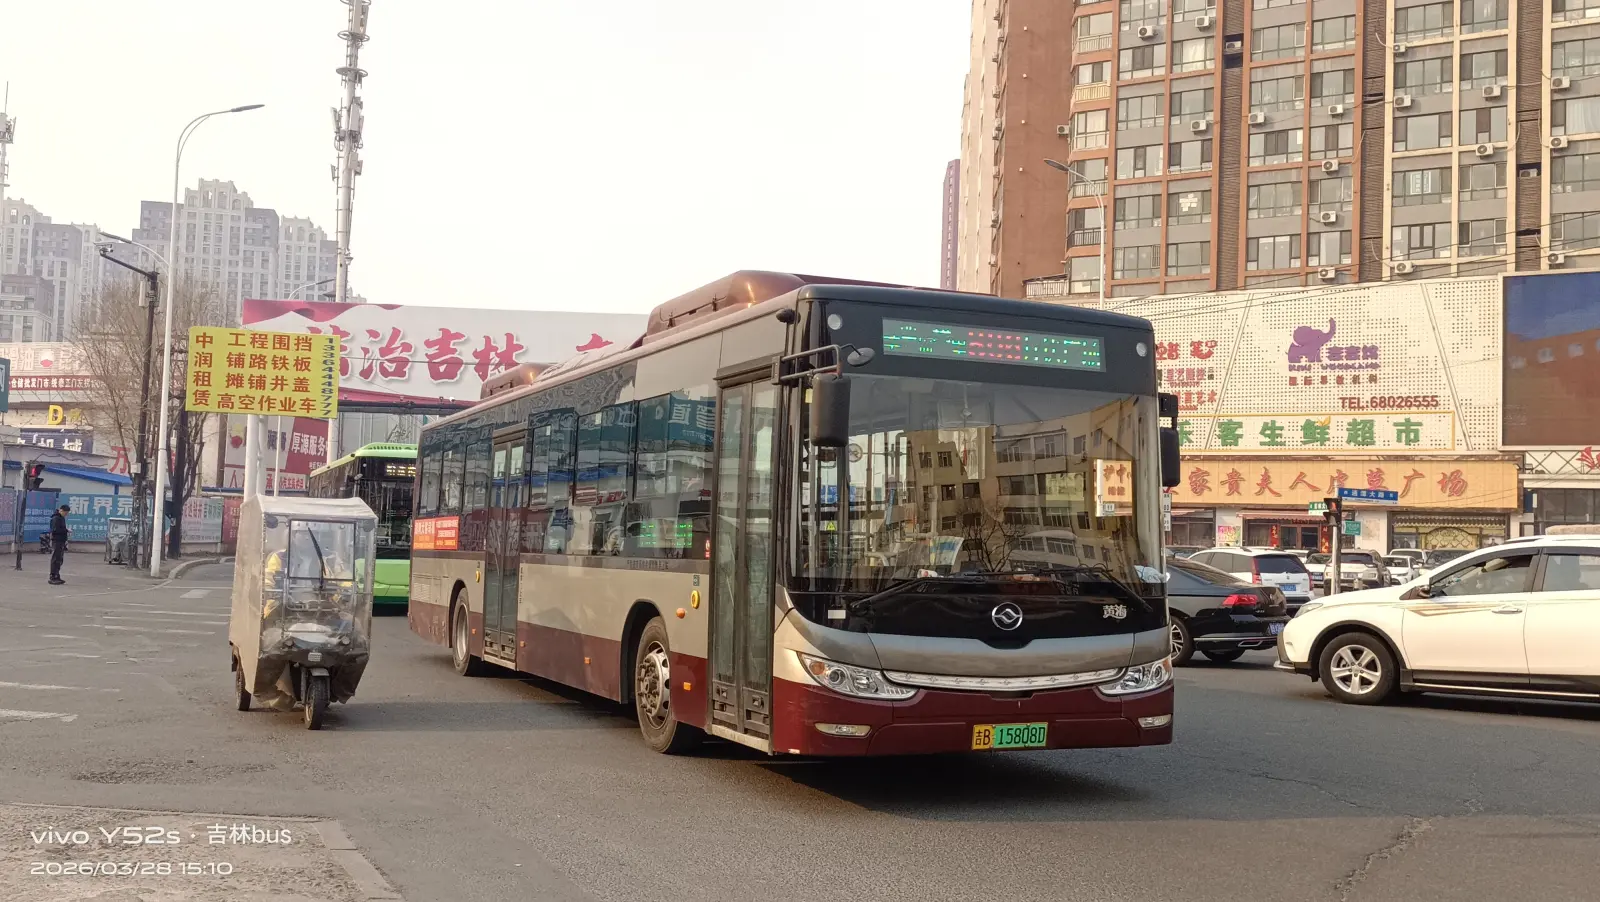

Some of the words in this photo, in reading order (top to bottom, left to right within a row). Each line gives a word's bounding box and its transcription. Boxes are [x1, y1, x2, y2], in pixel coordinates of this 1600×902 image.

[227, 332, 312, 352] 工程围挡
[192, 332, 214, 407] 中润租赁
[226, 352, 312, 372] 铺路铁板
[225, 372, 311, 393] 摊铺井盖
[319, 337, 336, 416] 13364448777
[216, 393, 317, 414] 高空作业车
[291, 432, 328, 457] 厚源服务
[1166, 466, 1469, 498] 家贵夫人皮草广场
[1102, 604, 1127, 619] 黄海
